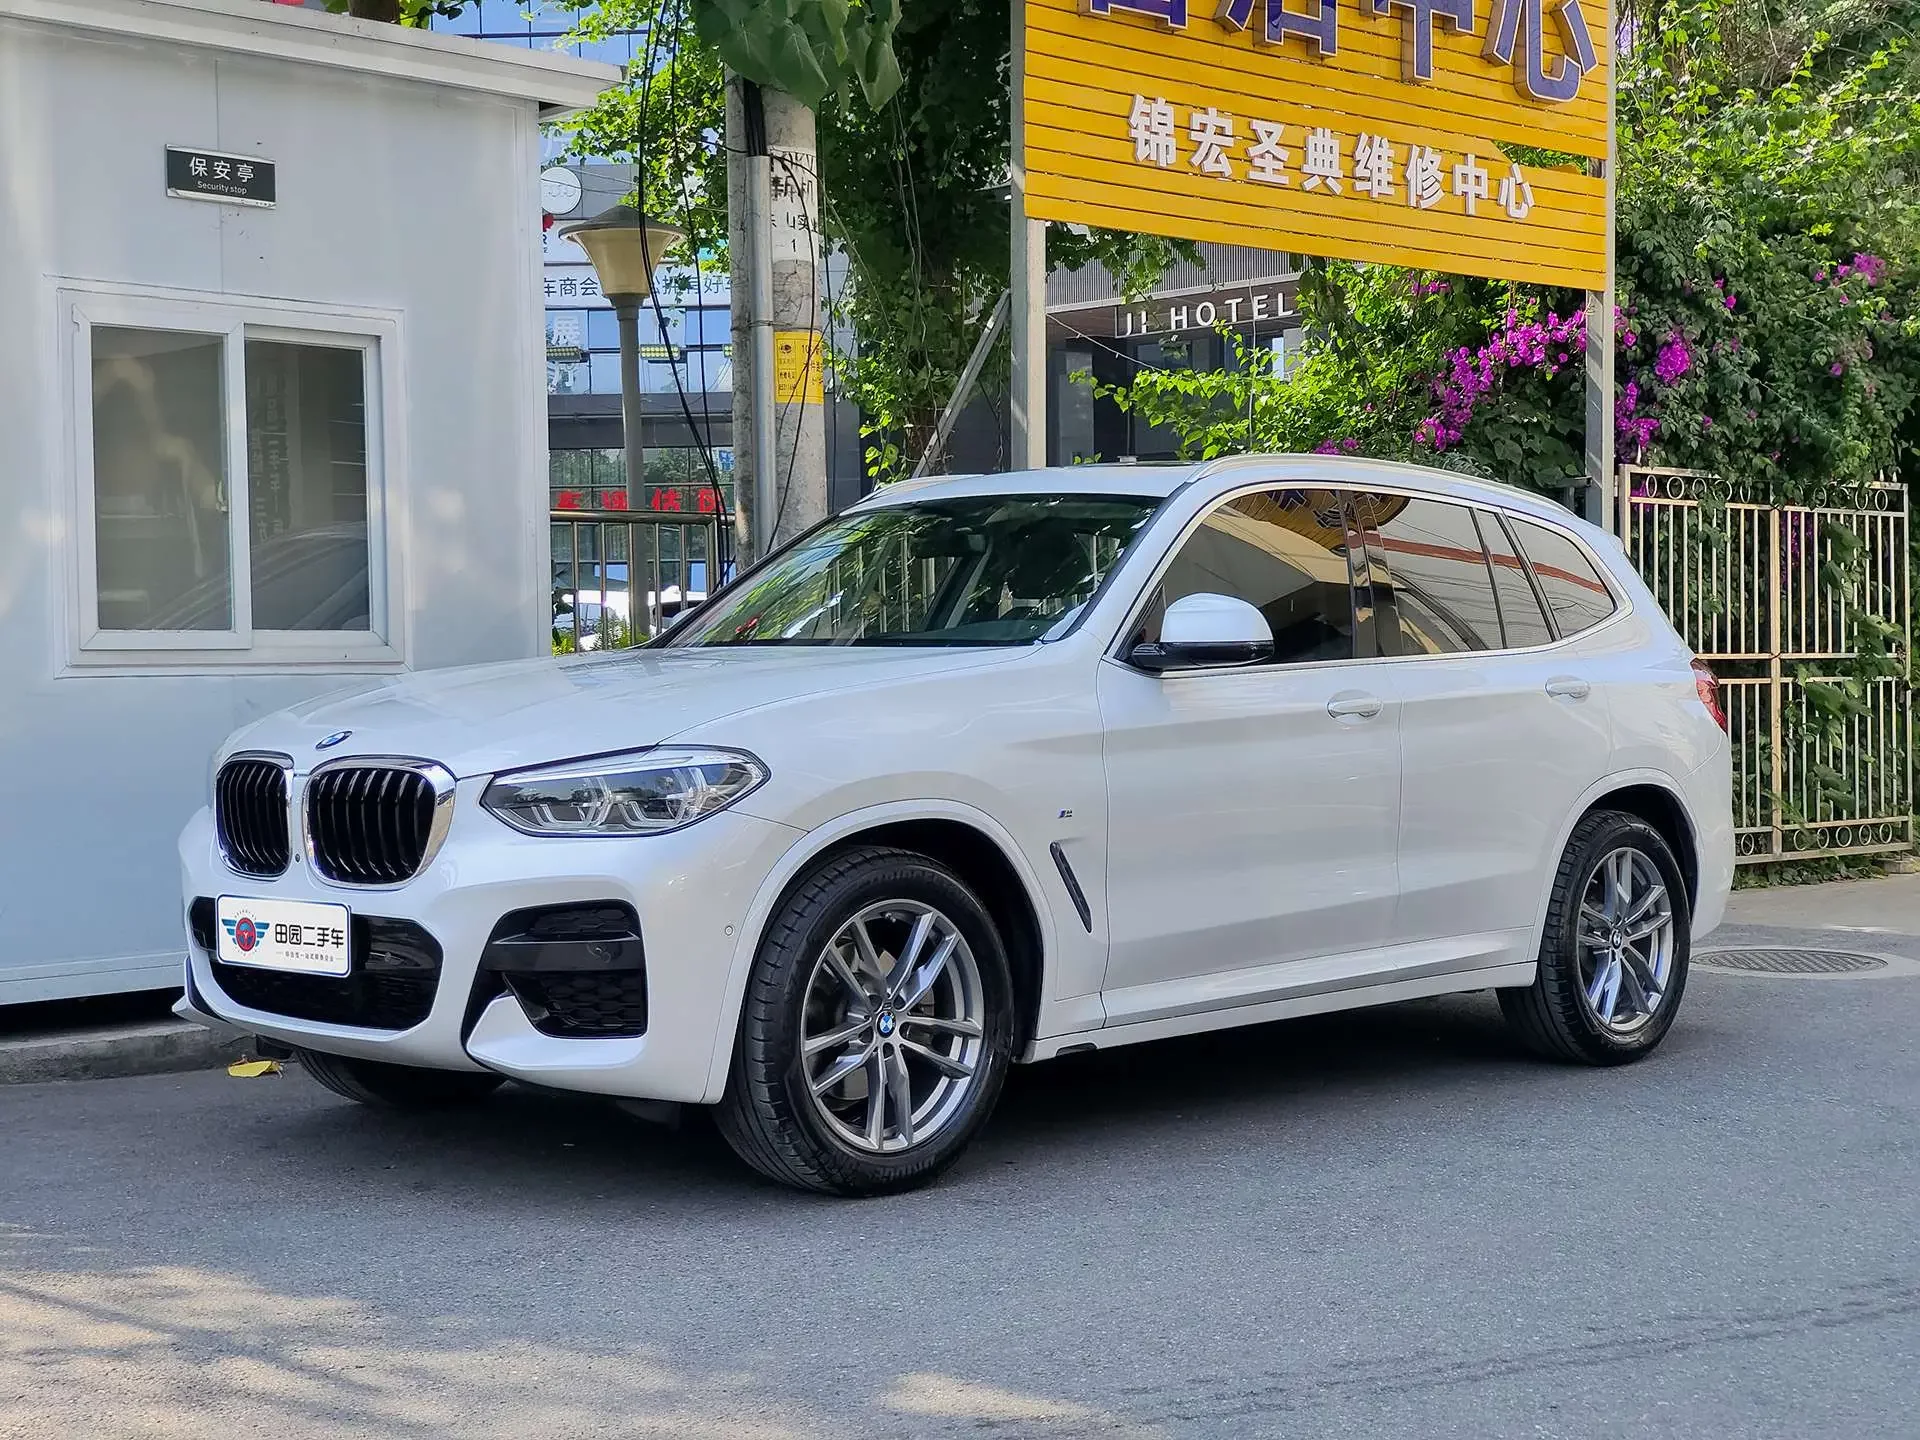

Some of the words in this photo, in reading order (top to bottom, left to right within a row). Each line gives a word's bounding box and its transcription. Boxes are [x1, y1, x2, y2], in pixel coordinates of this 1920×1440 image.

[189, 156, 254, 183] 保安亭
[1128, 93, 1536, 219] 锦宏圣典维修中心
[197, 181, 229, 193] Security
[229, 184, 247, 195] stop
[1170, 292, 1294, 331] HOTEL
[275, 923, 344, 949] 田园二手车
